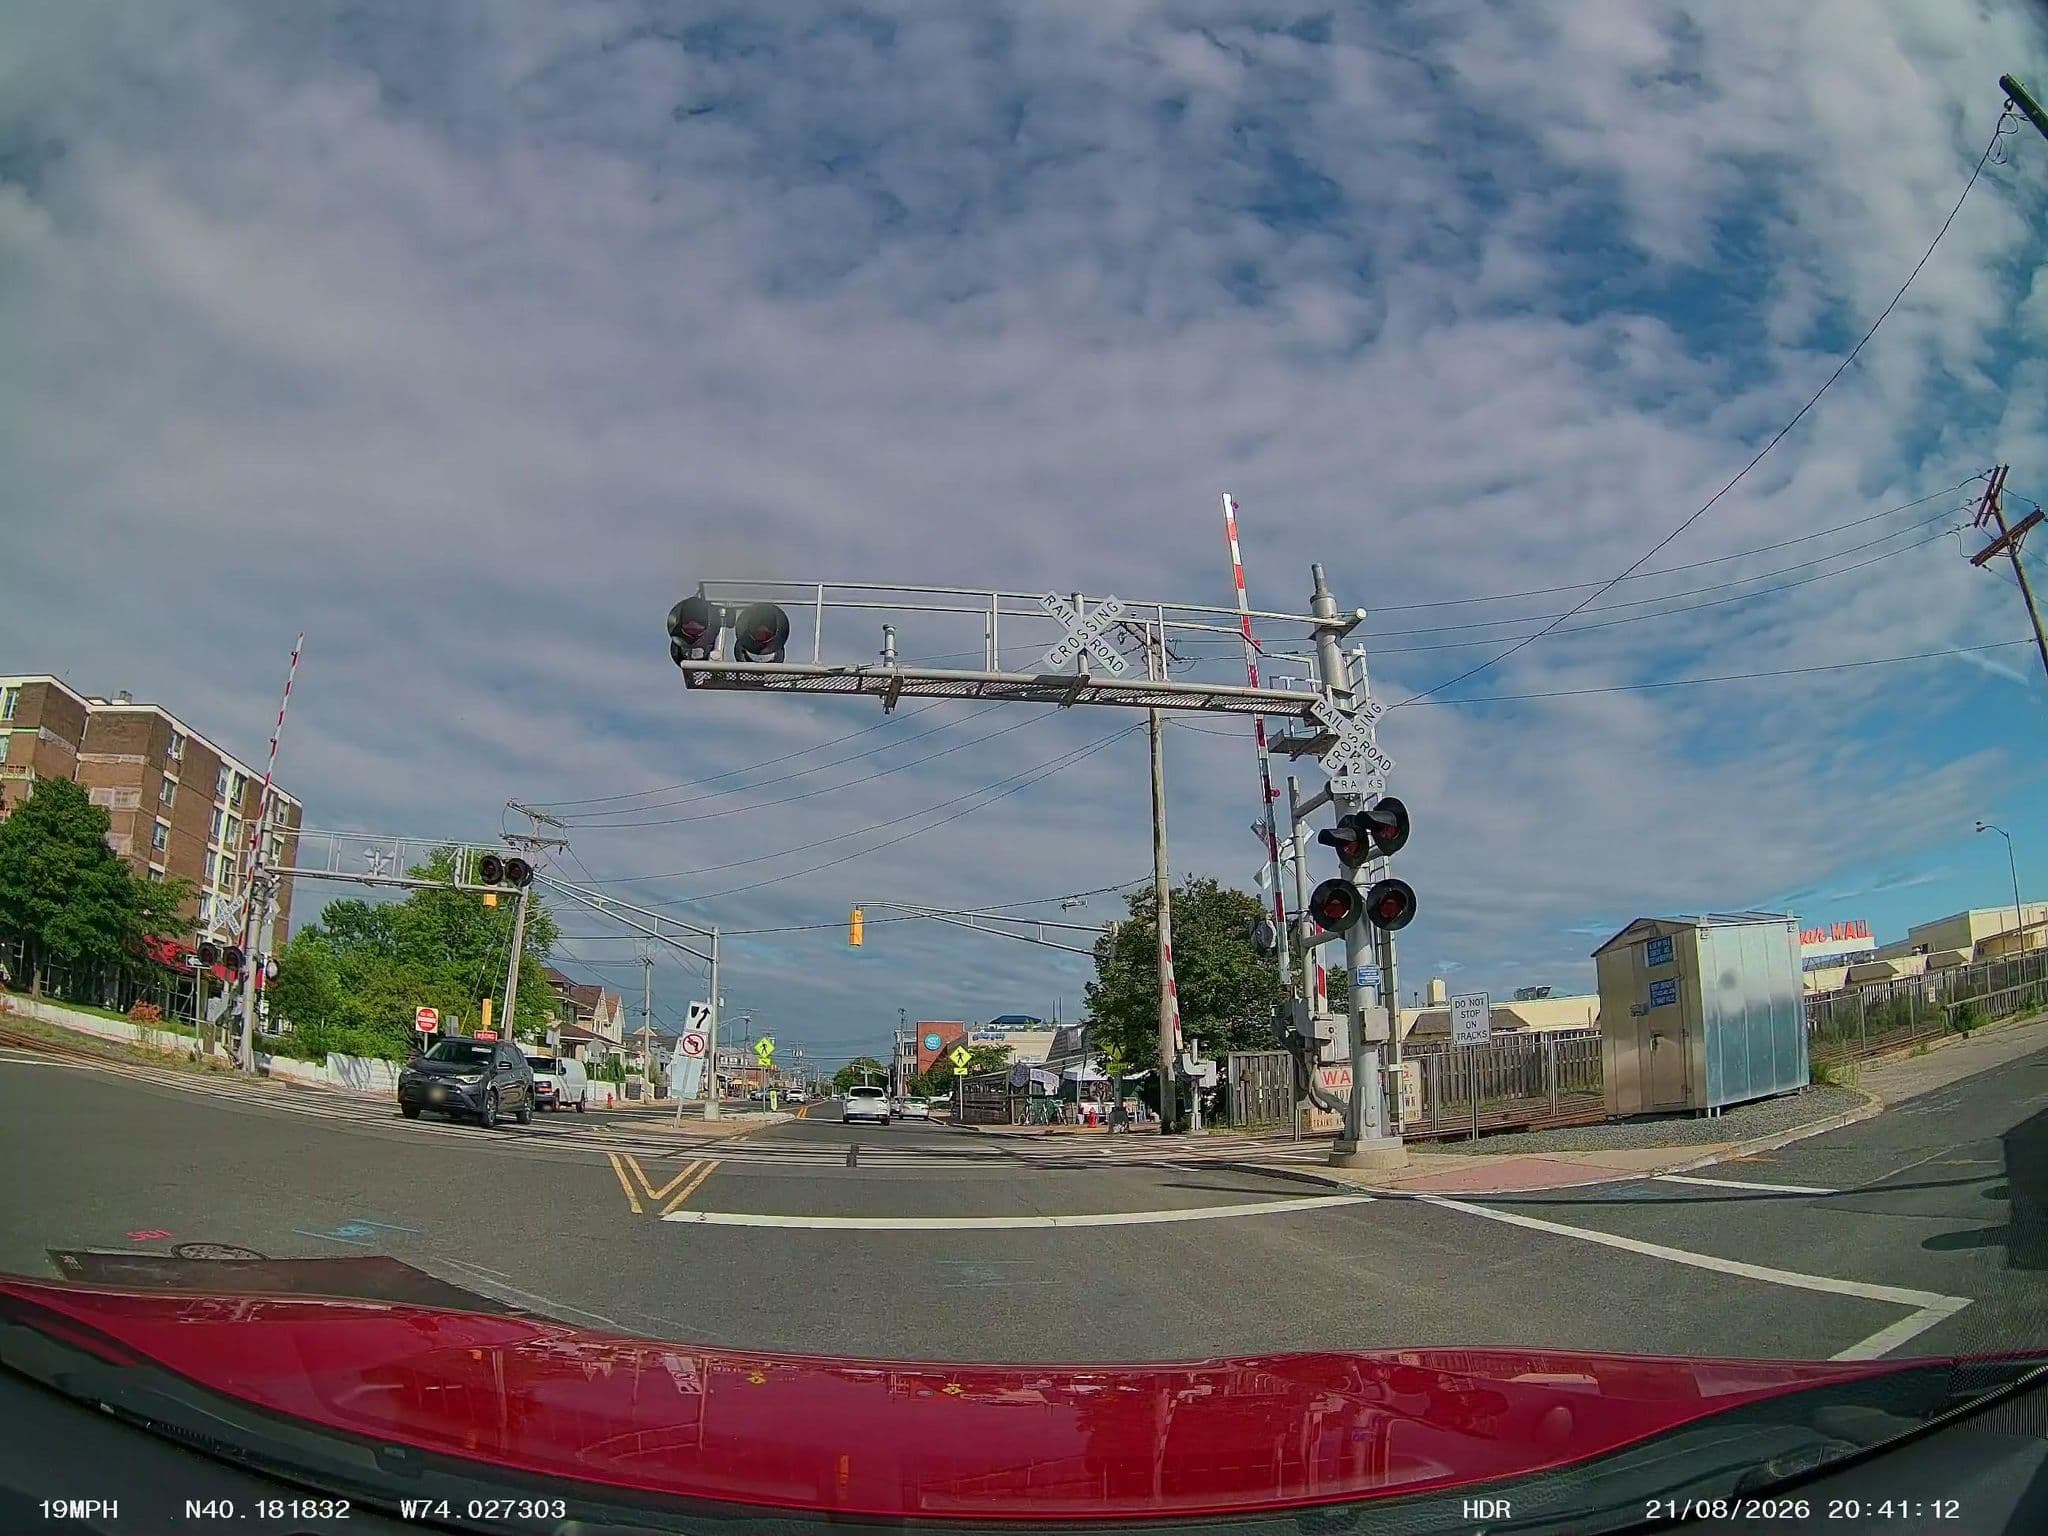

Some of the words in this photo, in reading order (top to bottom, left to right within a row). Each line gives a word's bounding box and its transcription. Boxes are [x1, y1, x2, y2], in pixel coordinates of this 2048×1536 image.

[1044, 595, 1073, 627] RAIL
[1090, 639, 1124, 672] ROAD
[1050, 602, 1119, 665] CROSSING
[1315, 702, 1343, 731] RAIL
[1360, 741, 1391, 771] ROAD
[1326, 703, 1382, 770] CROSSING
[1352, 762, 1361, 774] 2
[1831, 920, 1873, 940] MALL
[1455, 1000, 1466, 1009] DO
[1470, 998, 1484, 1007] NOT
[1461, 1010, 1481, 1019] STOP
[1466, 1021, 1477, 1029] ON
[1456, 1030, 1488, 1041] TRACKS
